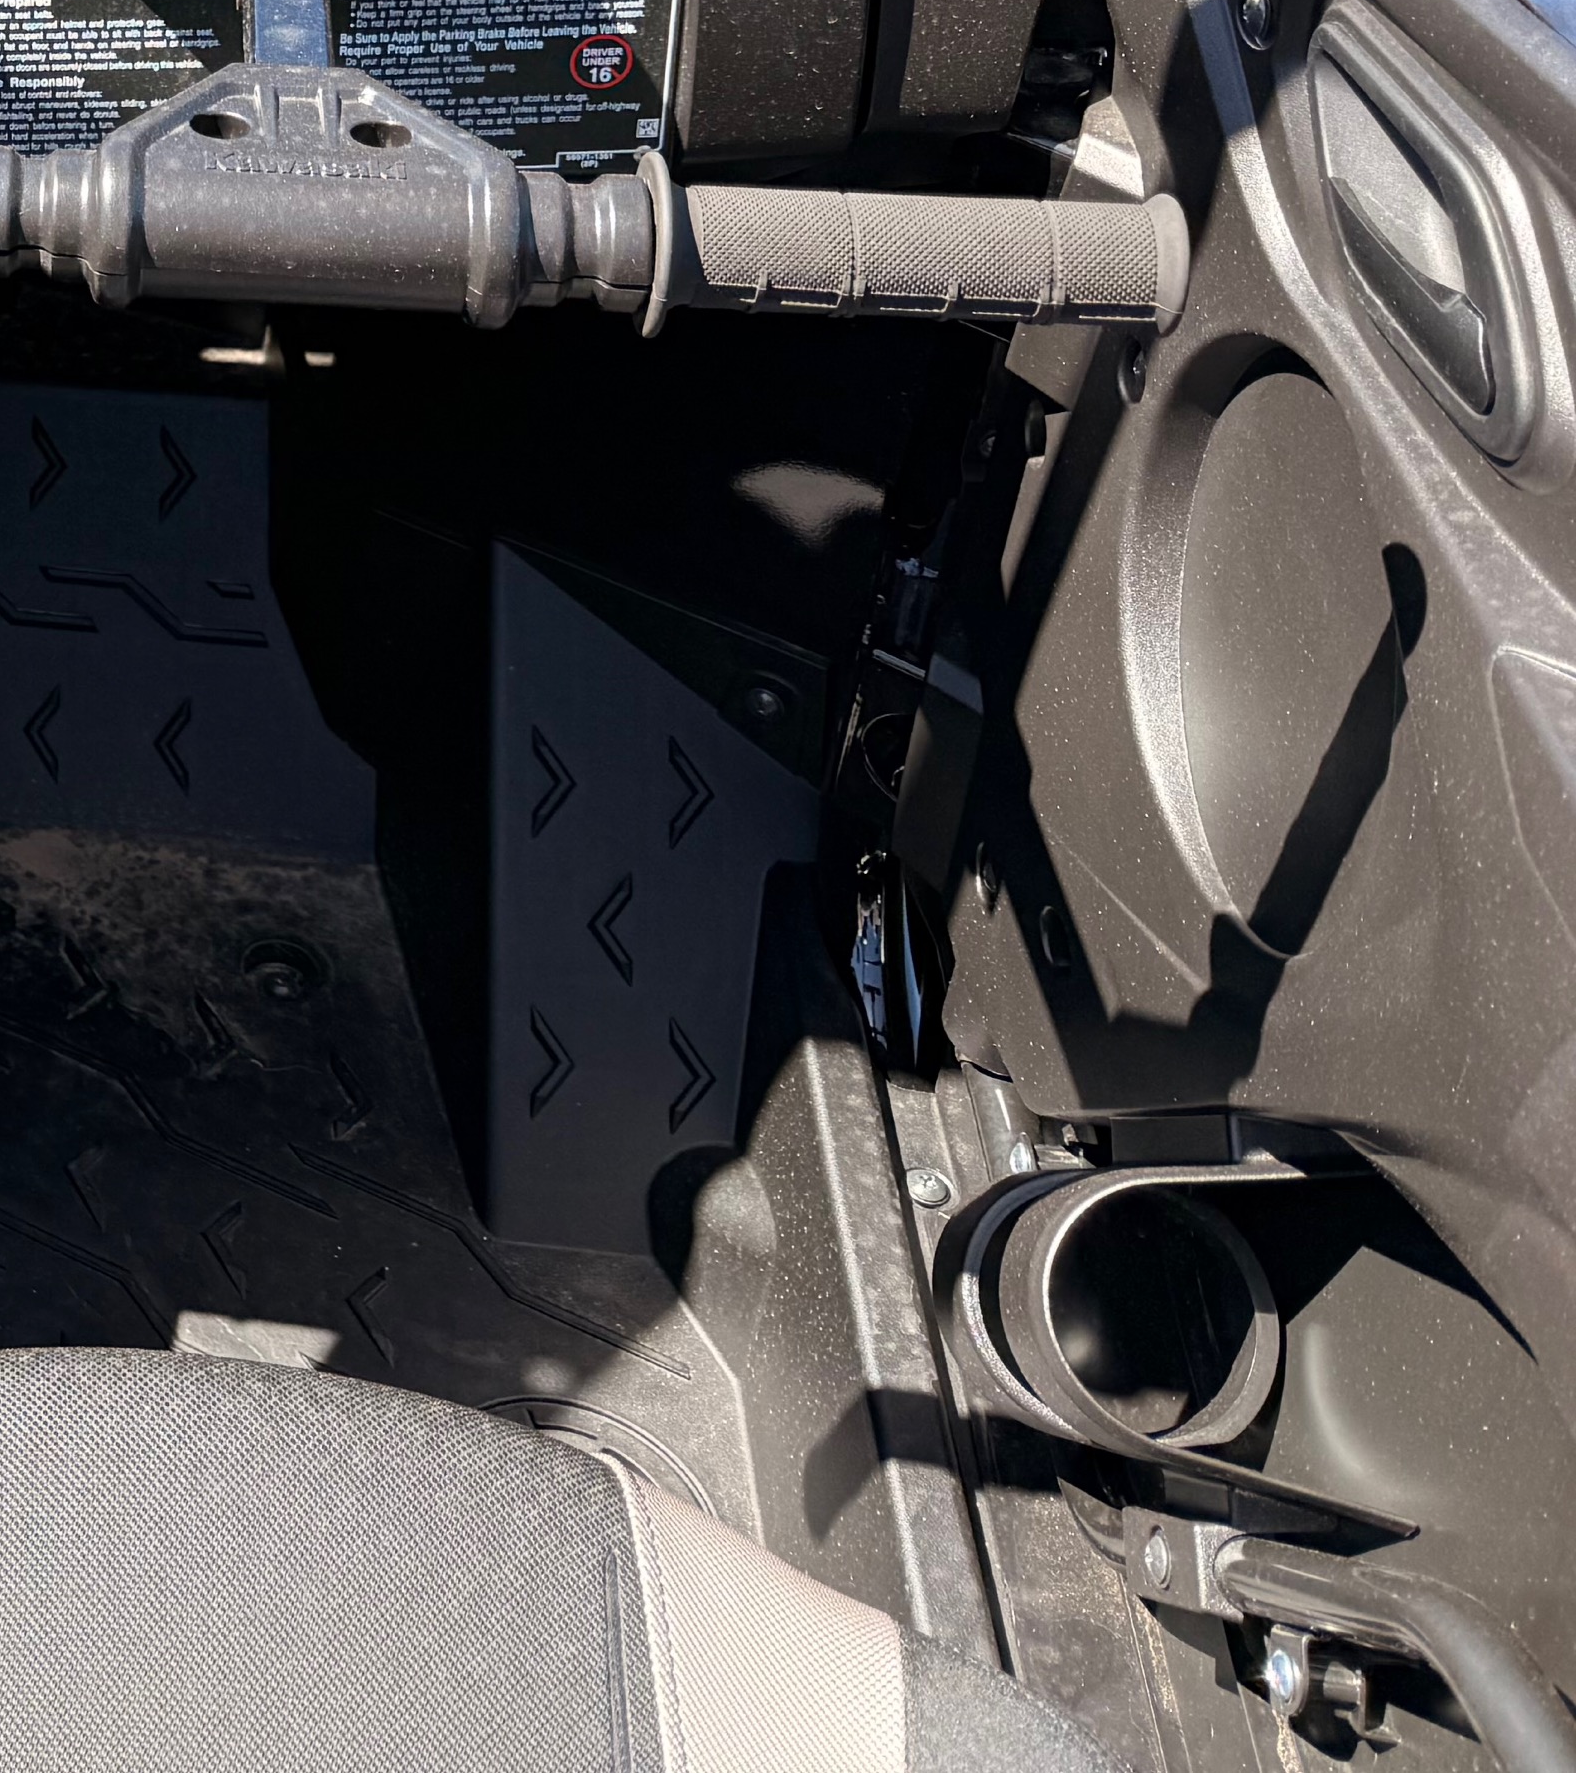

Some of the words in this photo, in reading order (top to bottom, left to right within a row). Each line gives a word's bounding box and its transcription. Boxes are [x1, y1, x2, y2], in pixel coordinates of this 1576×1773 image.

[340, 33, 353, 44] Be
[355, 33, 377, 43] Sure
[380, 32, 390, 43] to
[391, 31, 420, 44] Apply
[421, 30, 437, 41] the
[439, 29, 475, 42] Parking
[477, 27, 505, 39] Brake
[508, 27, 540, 38] Before
[542, 25, 579, 38] Leaving
[581, 24, 597, 35] the
[339, 45, 381, 58] Require
[387, 44, 425, 56] Proper
[430, 42, 451, 53] Use
[457, 42, 468, 52] of
[474, 41, 499, 51] Your
[504, 39, 544, 50] Vehicle
[582, 47, 623, 57] DRIVER
[582, 56, 621, 66] UNDER
[10, 75, 85, 90] Responsibly
[589, 67, 612, 83] 16
[205, 151, 407, 180] Kawasaki
